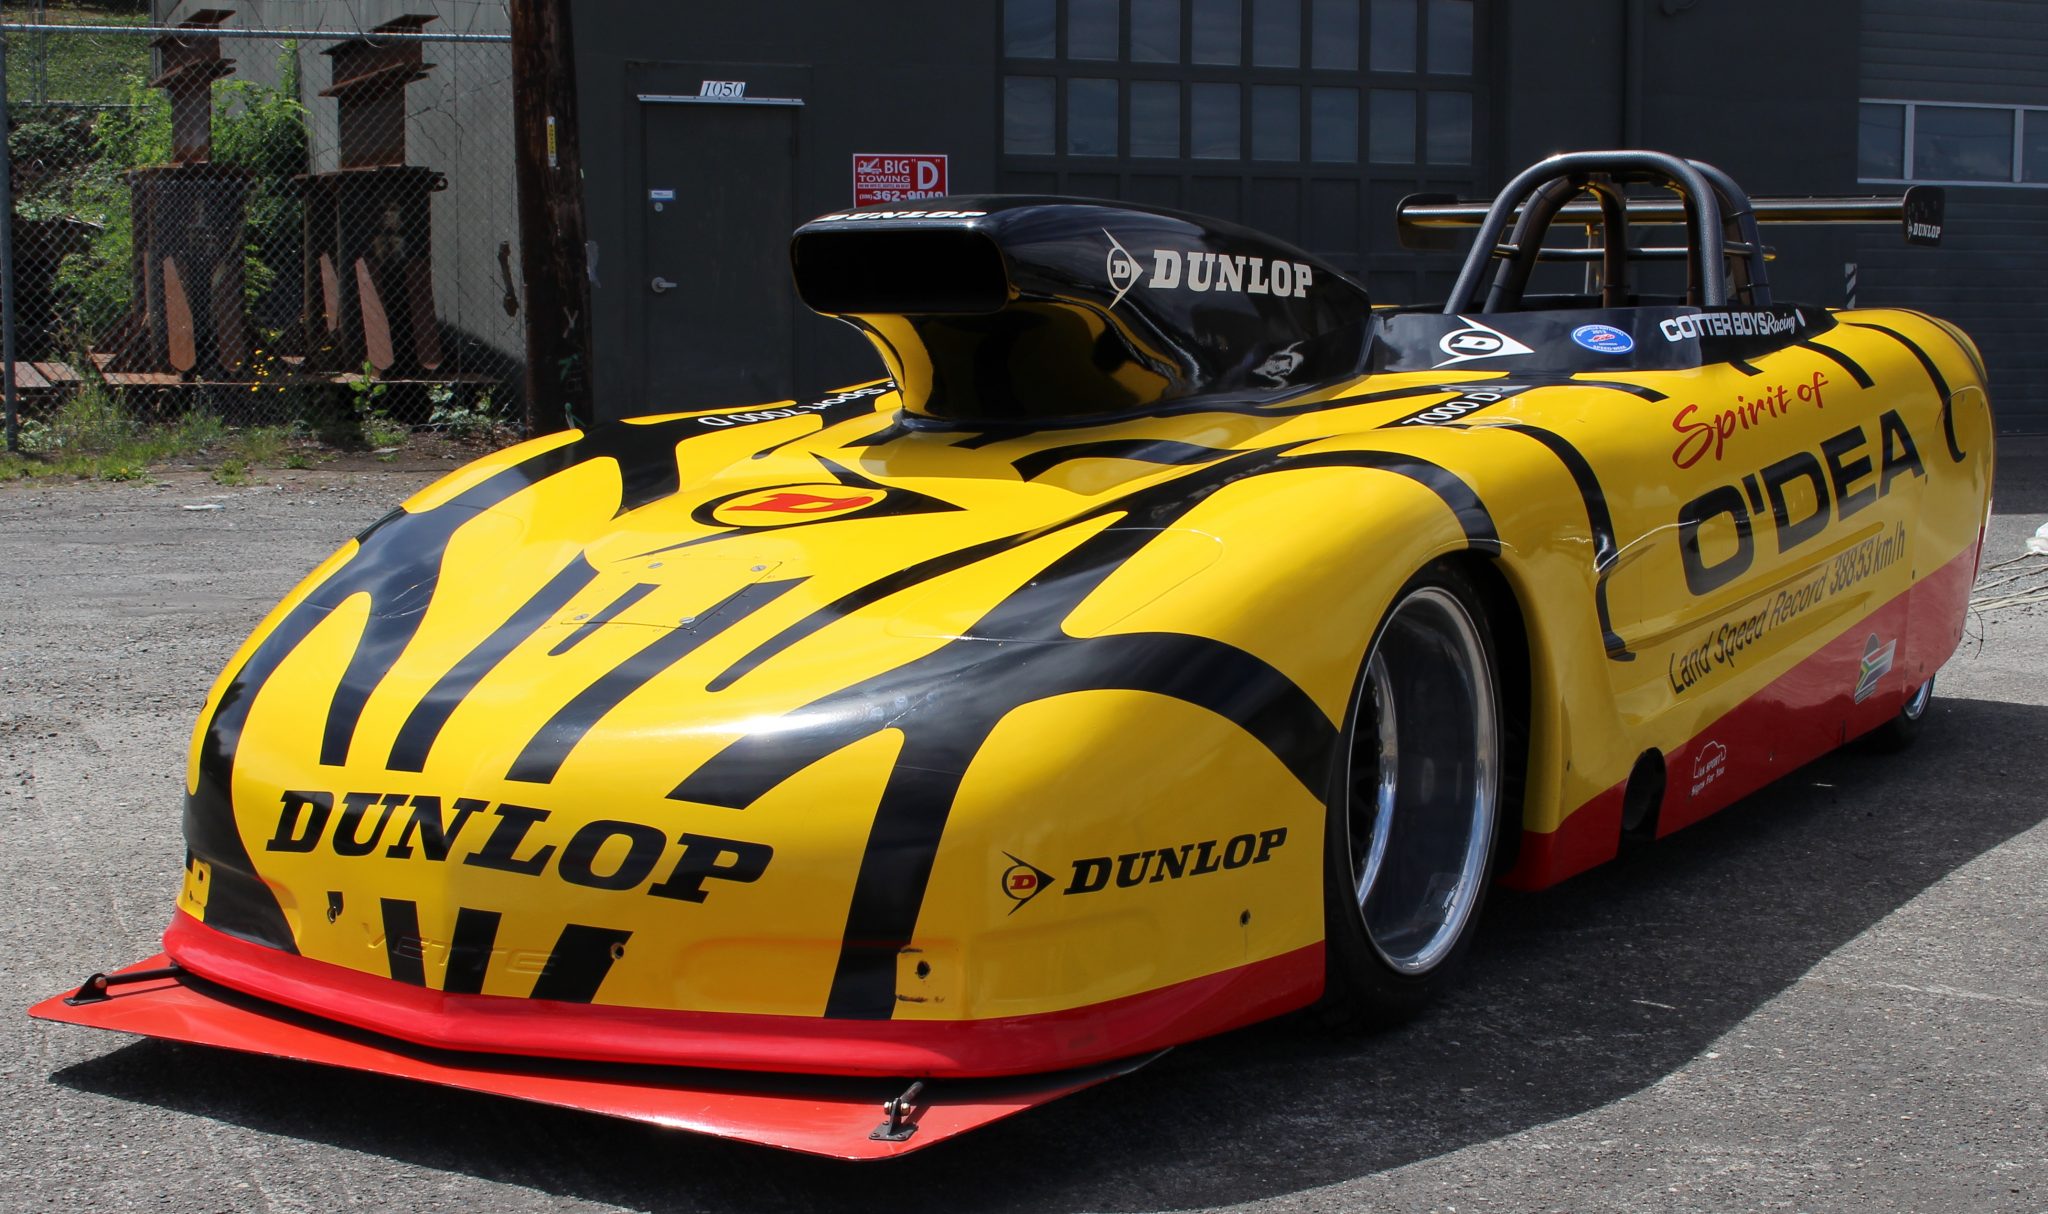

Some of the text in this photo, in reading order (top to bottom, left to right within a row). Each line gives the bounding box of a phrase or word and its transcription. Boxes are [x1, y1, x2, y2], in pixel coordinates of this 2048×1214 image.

[704, 82, 744, 97] 1050
[859, 175, 911, 183] TOWING
[884, 160, 910, 174] BIG
[812, 211, 988, 223] DUNLOP
[1912, 222, 1941, 239] DUNLOP
[1149, 249, 1313, 298] DUNLOP
[1659, 311, 1796, 342] COTTER BOYS Racing
[697, 387, 886, 427] Sport 7000 D
[1401, 392, 1502, 425] 7000 D
[1672, 371, 1830, 470] Spirit of
[1677, 408, 1926, 597] O'DEA
[1668, 630, 1714, 695] Land
[1713, 602, 1769, 669] Speed
[1767, 565, 1830, 632] Record
[1872, 519, 1905, 574] km/h
[266, 791, 774, 904] DUNLOP
[1063, 827, 1288, 896] DUNLOP
